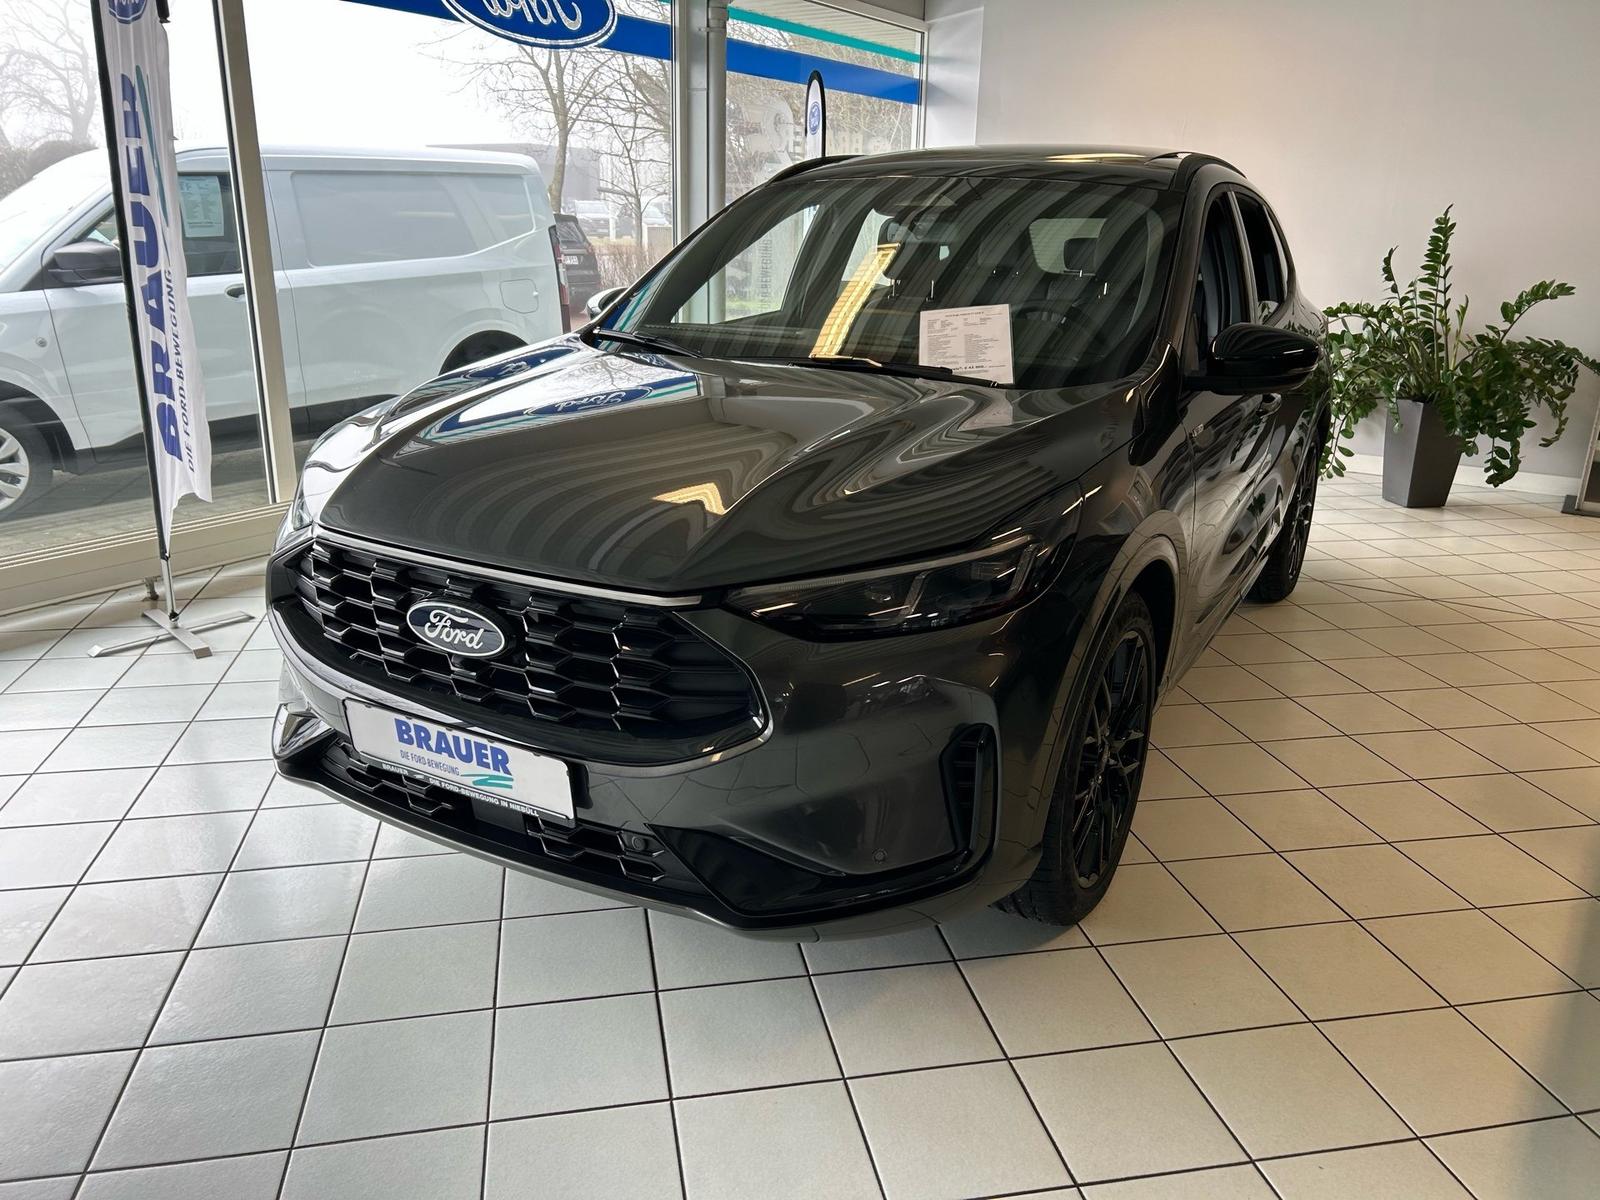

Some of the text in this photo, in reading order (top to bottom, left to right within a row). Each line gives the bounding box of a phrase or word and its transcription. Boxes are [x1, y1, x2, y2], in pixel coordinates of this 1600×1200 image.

[121, 73, 183, 462] BRAUER
[183, 440, 195, 473] DIE
[424, 609, 484, 650] Ford
[394, 718, 513, 775] BRAUER
[400, 750, 410, 760] DIE
[382, 763, 409, 776] BRAUER
[429, 777, 441, 787] DIE
[500, 799, 509, 808] IN
